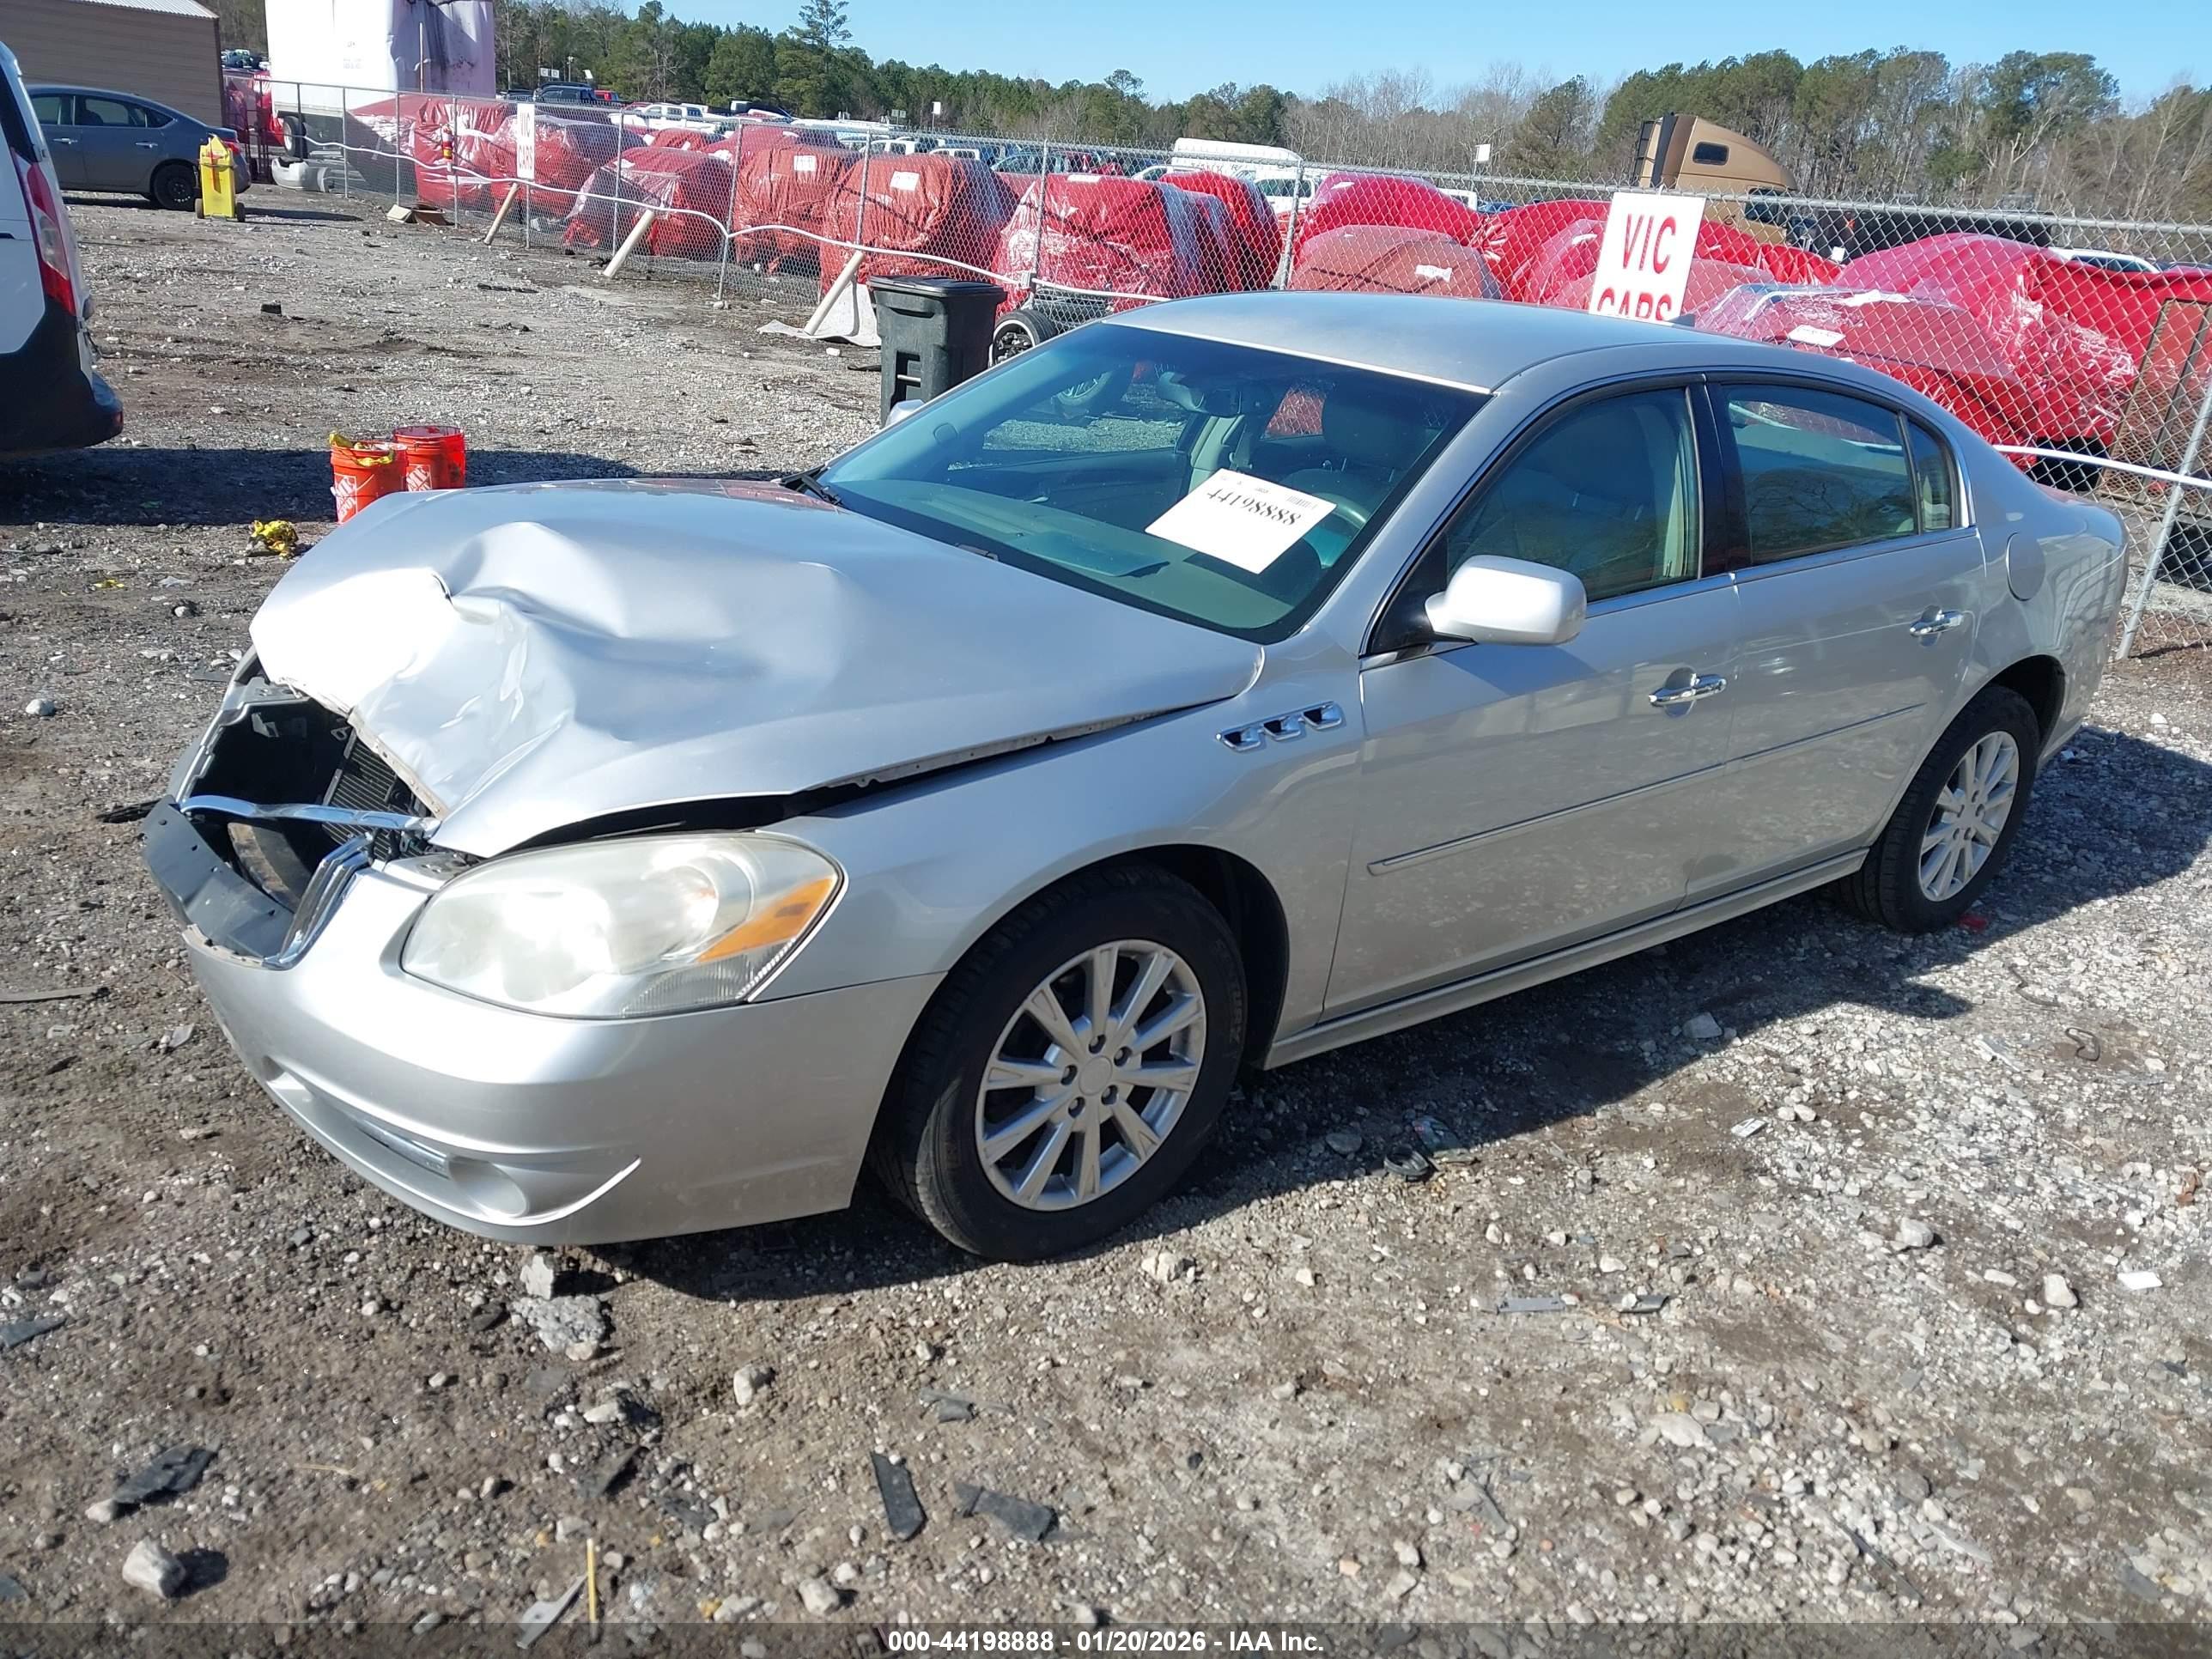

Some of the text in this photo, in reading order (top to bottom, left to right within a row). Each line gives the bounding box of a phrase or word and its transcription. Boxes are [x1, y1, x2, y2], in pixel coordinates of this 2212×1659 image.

[518, 144, 532, 170] CARS
[1623, 214, 1676, 274] VIC
[1206, 488, 1302, 526] 44198888
